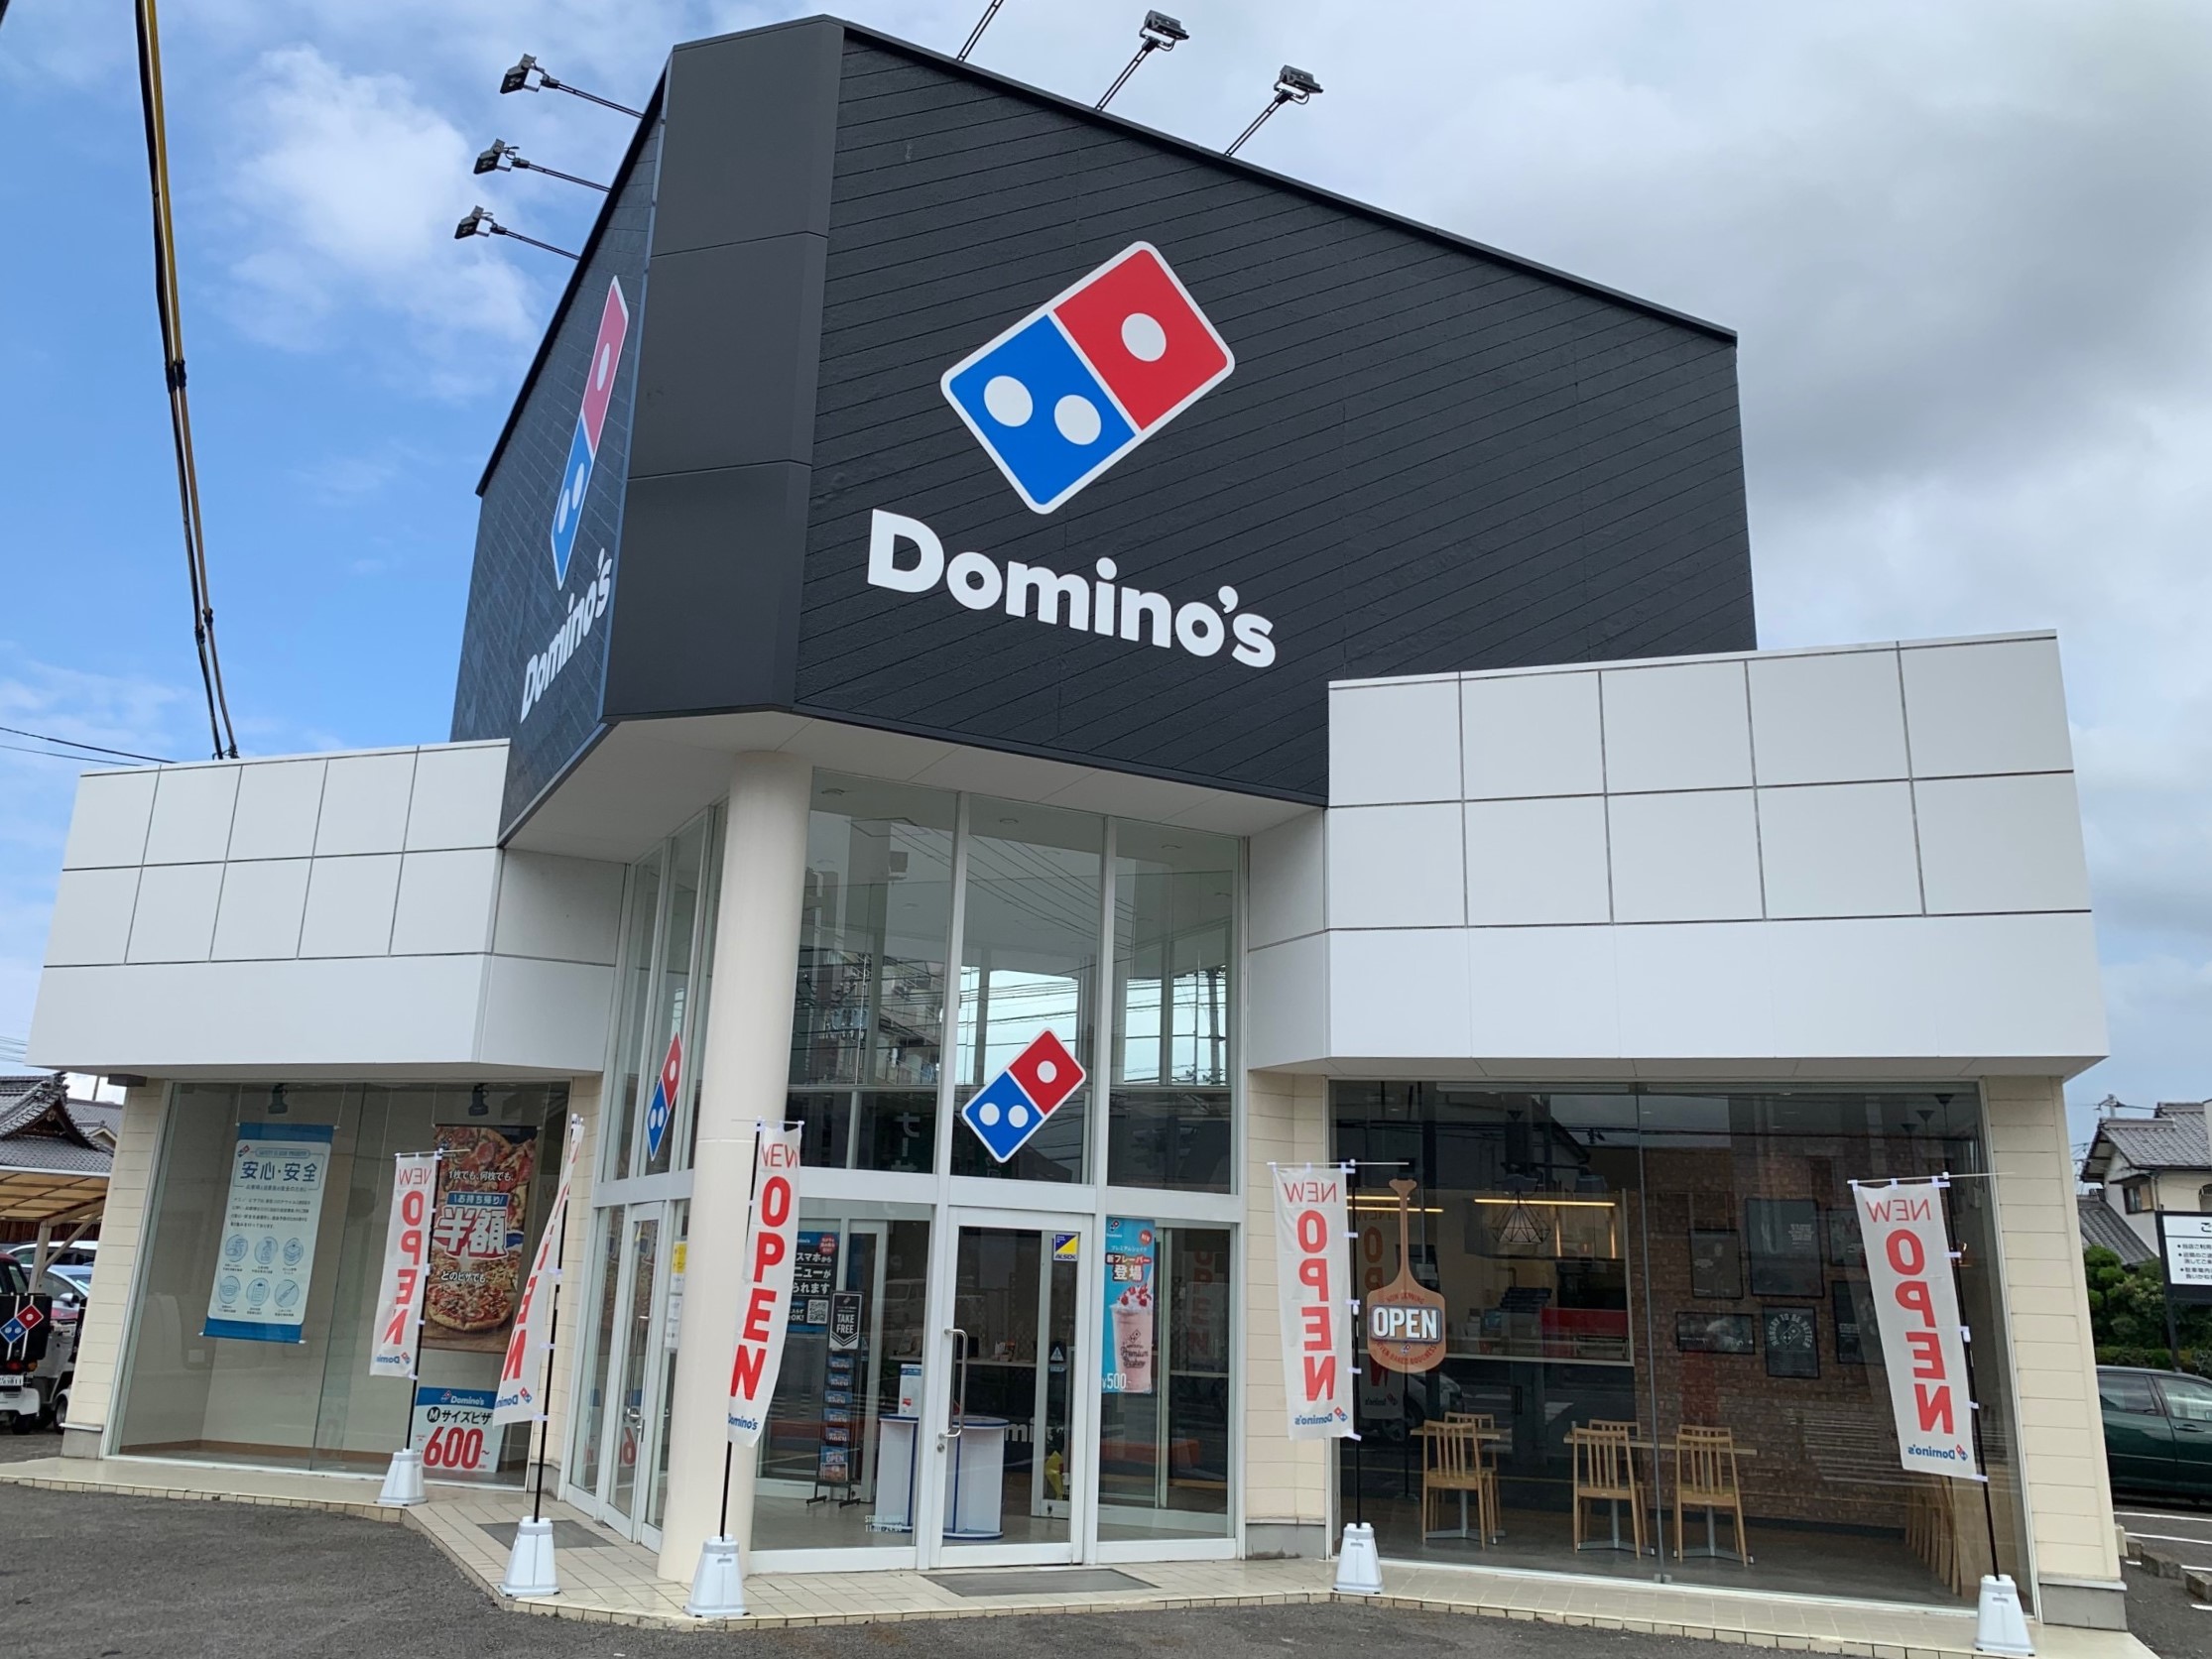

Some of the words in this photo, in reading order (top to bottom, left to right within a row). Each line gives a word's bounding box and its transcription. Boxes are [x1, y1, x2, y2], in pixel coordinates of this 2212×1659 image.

[867, 508, 1277, 668] Domino's
[520, 545, 613, 724] Domino's
[760, 1143, 799, 1169] NEW
[240, 1161, 317, 1182] 安心・安全
[433, 1207, 507, 1256] 半額
[1113, 1264, 1142, 1280] 登場
[730, 1176, 792, 1401] OPEN
[836, 1313, 855, 1324] TAKE
[836, 1324, 854, 1334] FREE
[1373, 1307, 1438, 1340] OPEN
[450, 1395, 485, 1406] Domino's
